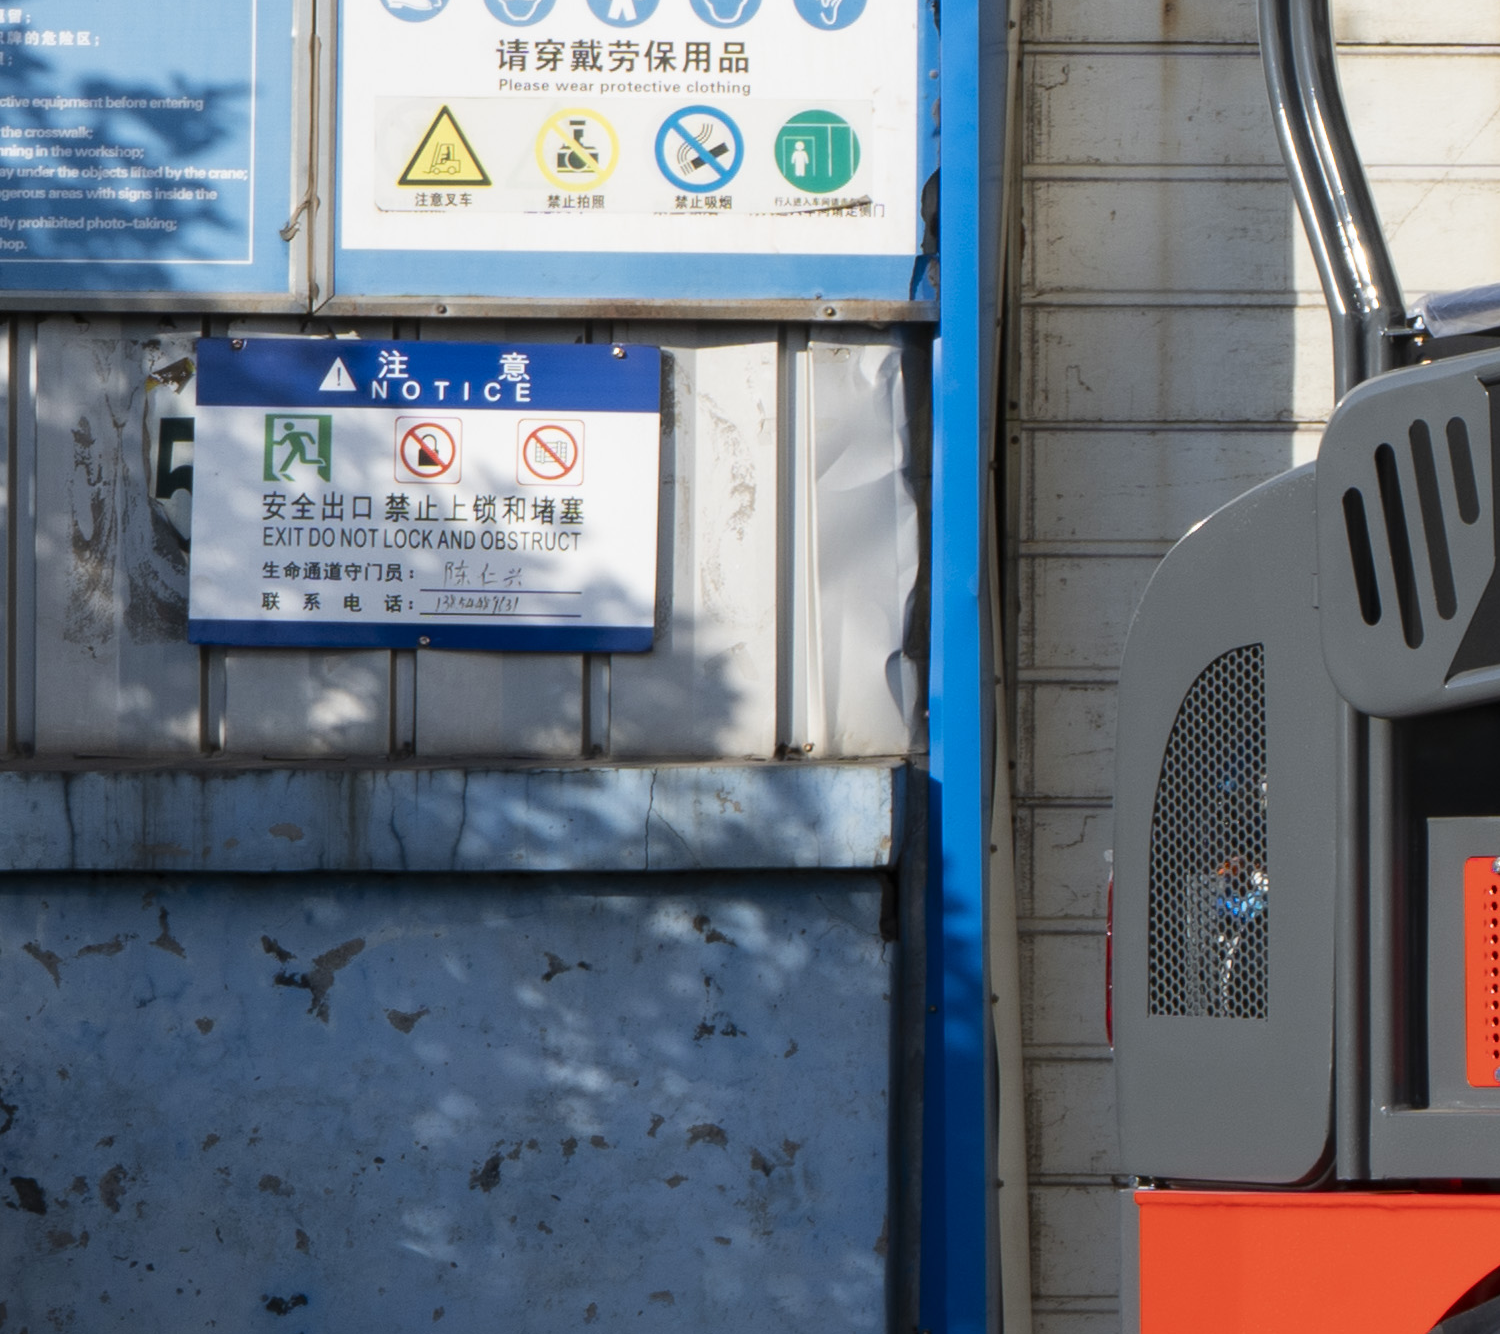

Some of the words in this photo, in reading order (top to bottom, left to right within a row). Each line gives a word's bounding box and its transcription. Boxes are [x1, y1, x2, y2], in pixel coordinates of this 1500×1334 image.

[496, 38, 749, 74] 请穿戴劳保用品
[499, 78, 550, 92] Please
[555, 81, 594, 92] wear
[600, 80, 681, 94] protective
[686, 80, 751, 96] clothing
[32, 96, 103, 110] equipment
[105, 96, 146, 109] before
[149, 97, 204, 111] entering
[1, 126, 22, 138] the
[24, 127, 93, 140] crosswalk;
[36, 144, 48, 157] in
[51, 145, 72, 157] the
[75, 147, 144, 160] workshop;
[17, 165, 55, 178] under
[57, 166, 78, 178] the
[81, 167, 128, 181] objects
[130, 167, 163, 179] lifted
[166, 167, 182, 181] by
[184, 168, 205, 179] the
[208, 170, 248, 181] crane;
[48, 190, 83, 199] areas
[86, 187, 116, 199] with
[118, 188, 151, 202] signs
[155, 188, 193, 200] inside
[195, 189, 217, 200] the
[415, 192, 473, 207] 注意叉车
[548, 195, 605, 209] 禁止拍照
[675, 195, 733, 210] 禁止吸烟
[18, 216, 84, 231] prohibited
[378, 350, 530, 381] 注意
[371, 381, 532, 403] NOTICE
[262, 492, 373, 523] 安全出口
[385, 494, 585, 526] 禁止上锁和堵塞
[263, 527, 301, 547] EXIT
[308, 528, 335, 548] DO
[341, 528, 377, 549] NOT
[384, 528, 433, 550] LOCK
[438, 529, 476, 550] AND
[480, 530, 582, 551] OBSTRUCT
[262, 562, 415, 582] 生命通道守门员：
